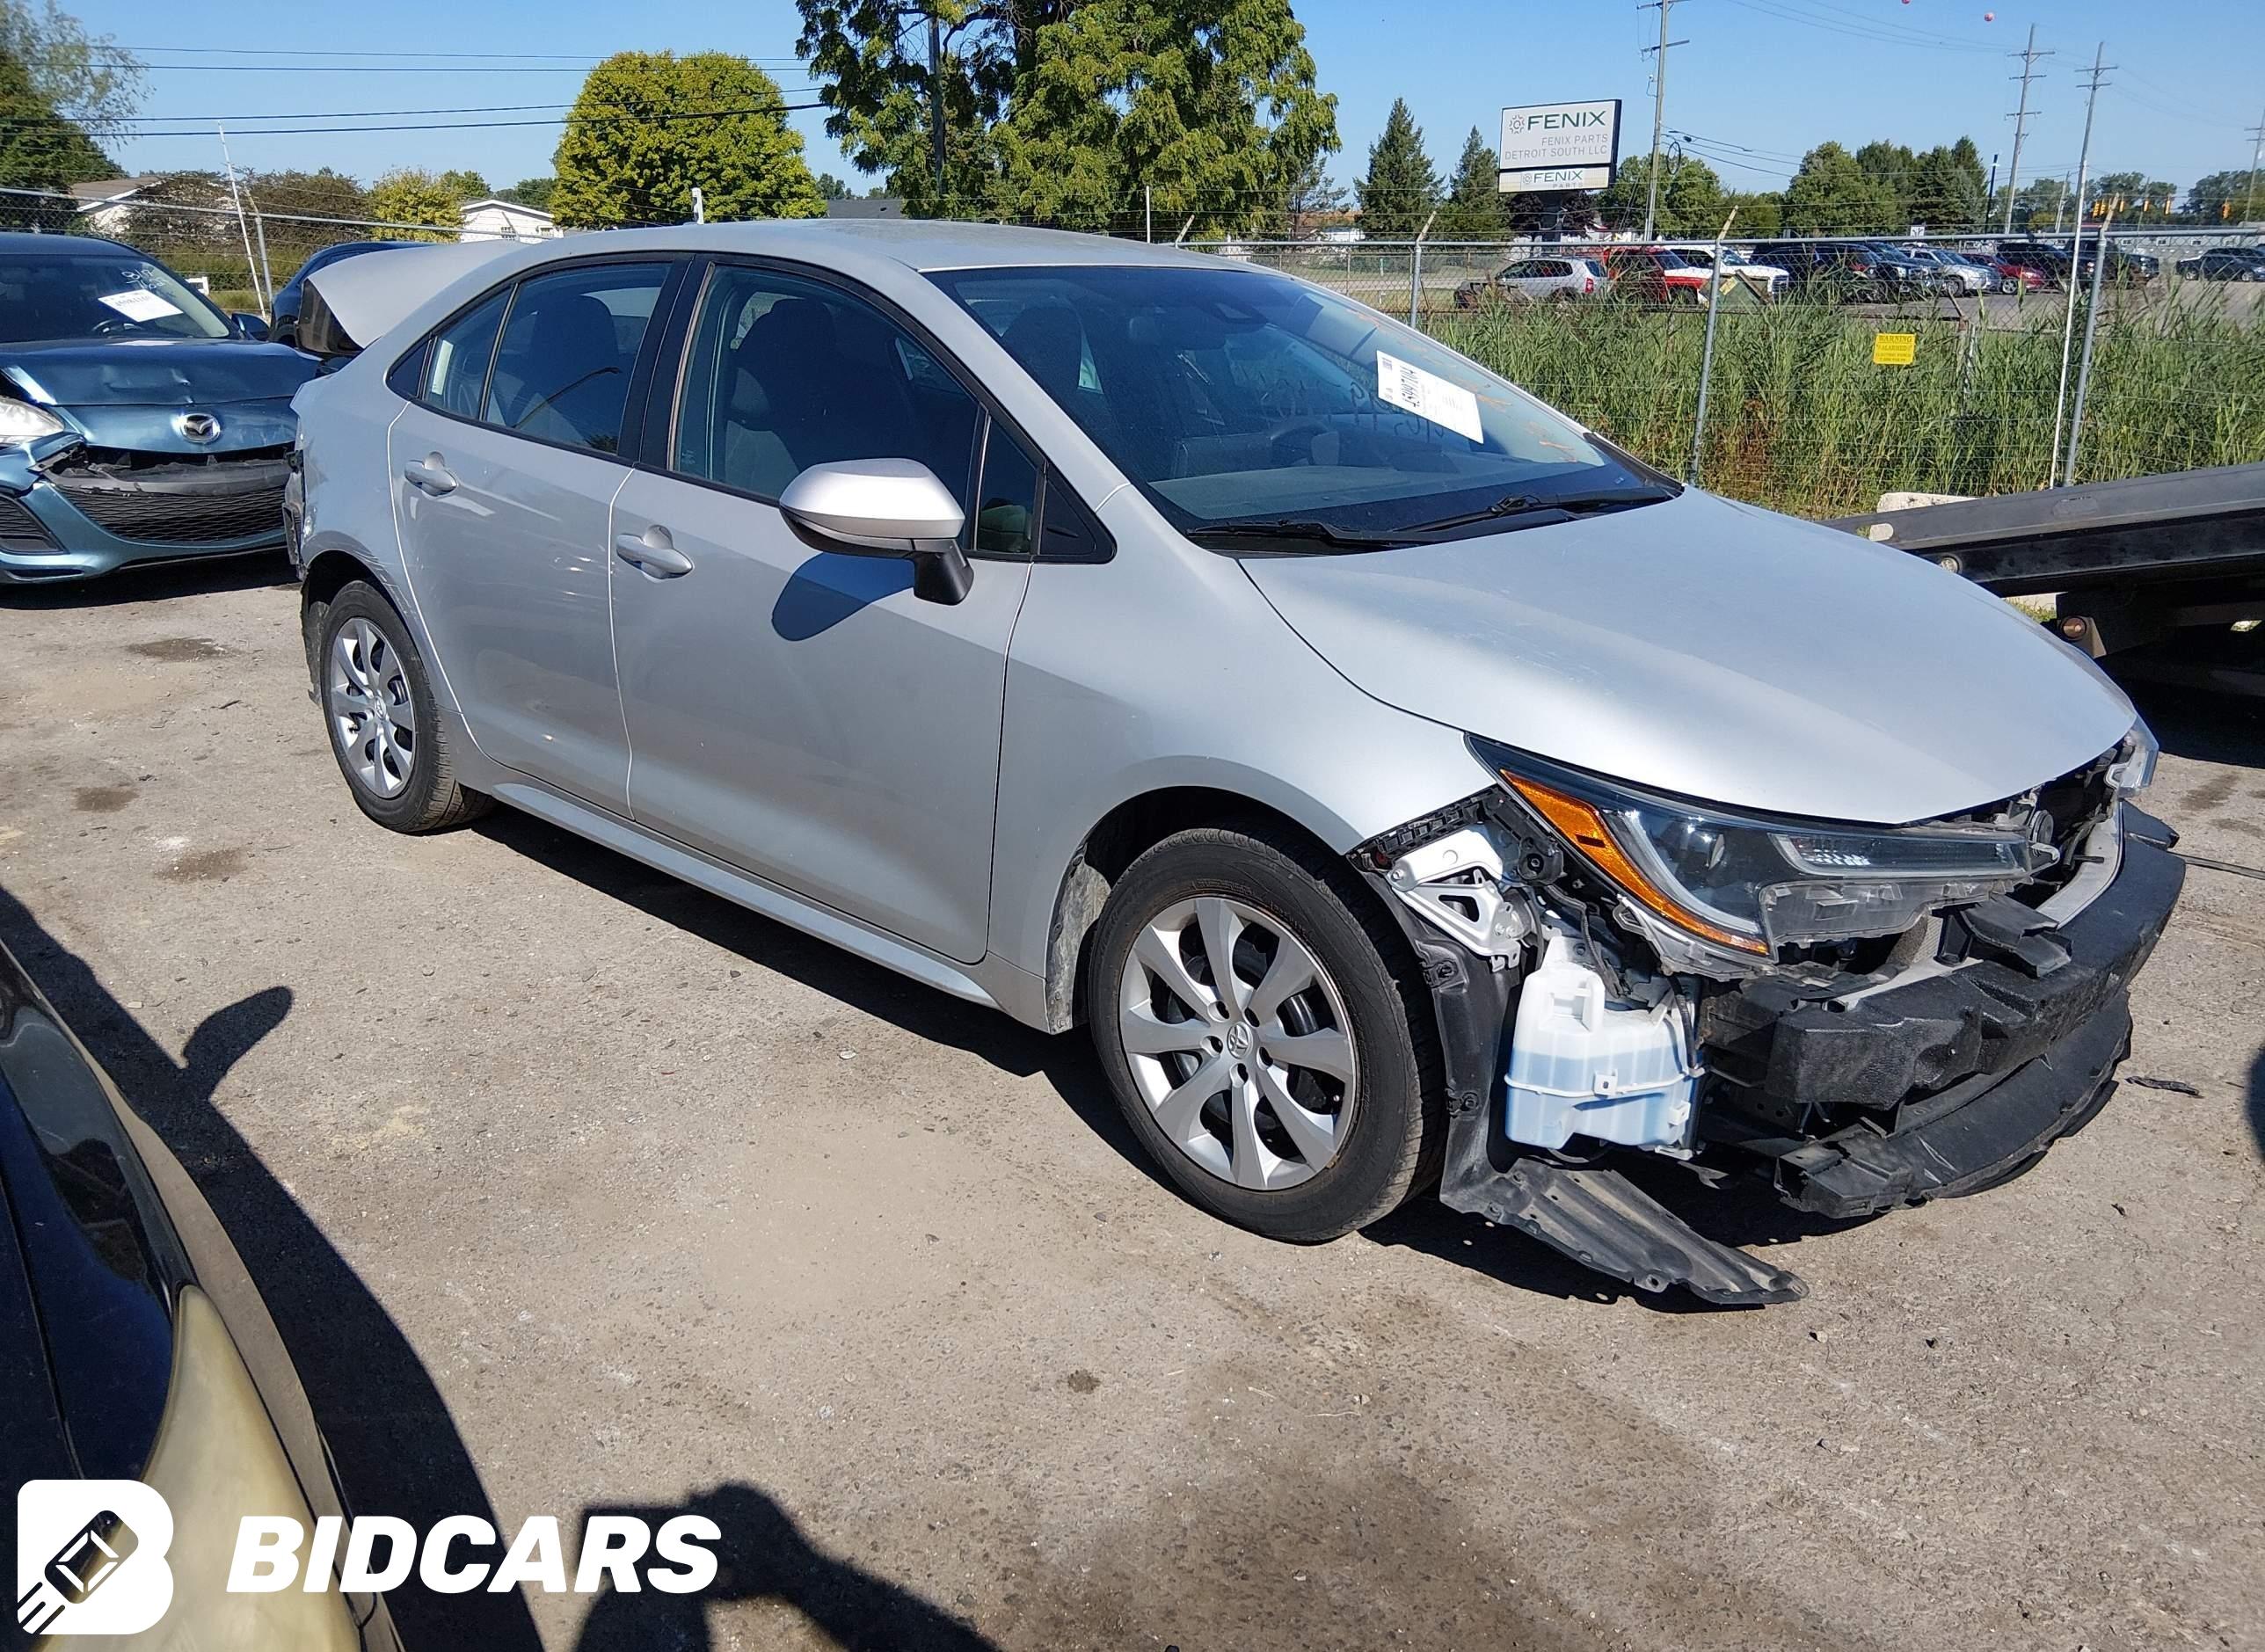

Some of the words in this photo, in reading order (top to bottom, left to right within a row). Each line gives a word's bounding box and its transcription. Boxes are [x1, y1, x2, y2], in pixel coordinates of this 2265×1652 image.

[1527, 111, 1606, 131] FENIX
[1541, 136, 1571, 147] FENIX
[1574, 134, 1608, 144] PARTS
[1504, 149, 1548, 161] DETROIT
[1550, 147, 1584, 157] SOUTH
[1589, 145, 1607, 156] LLC
[1533, 171, 1583, 183] FENIX
